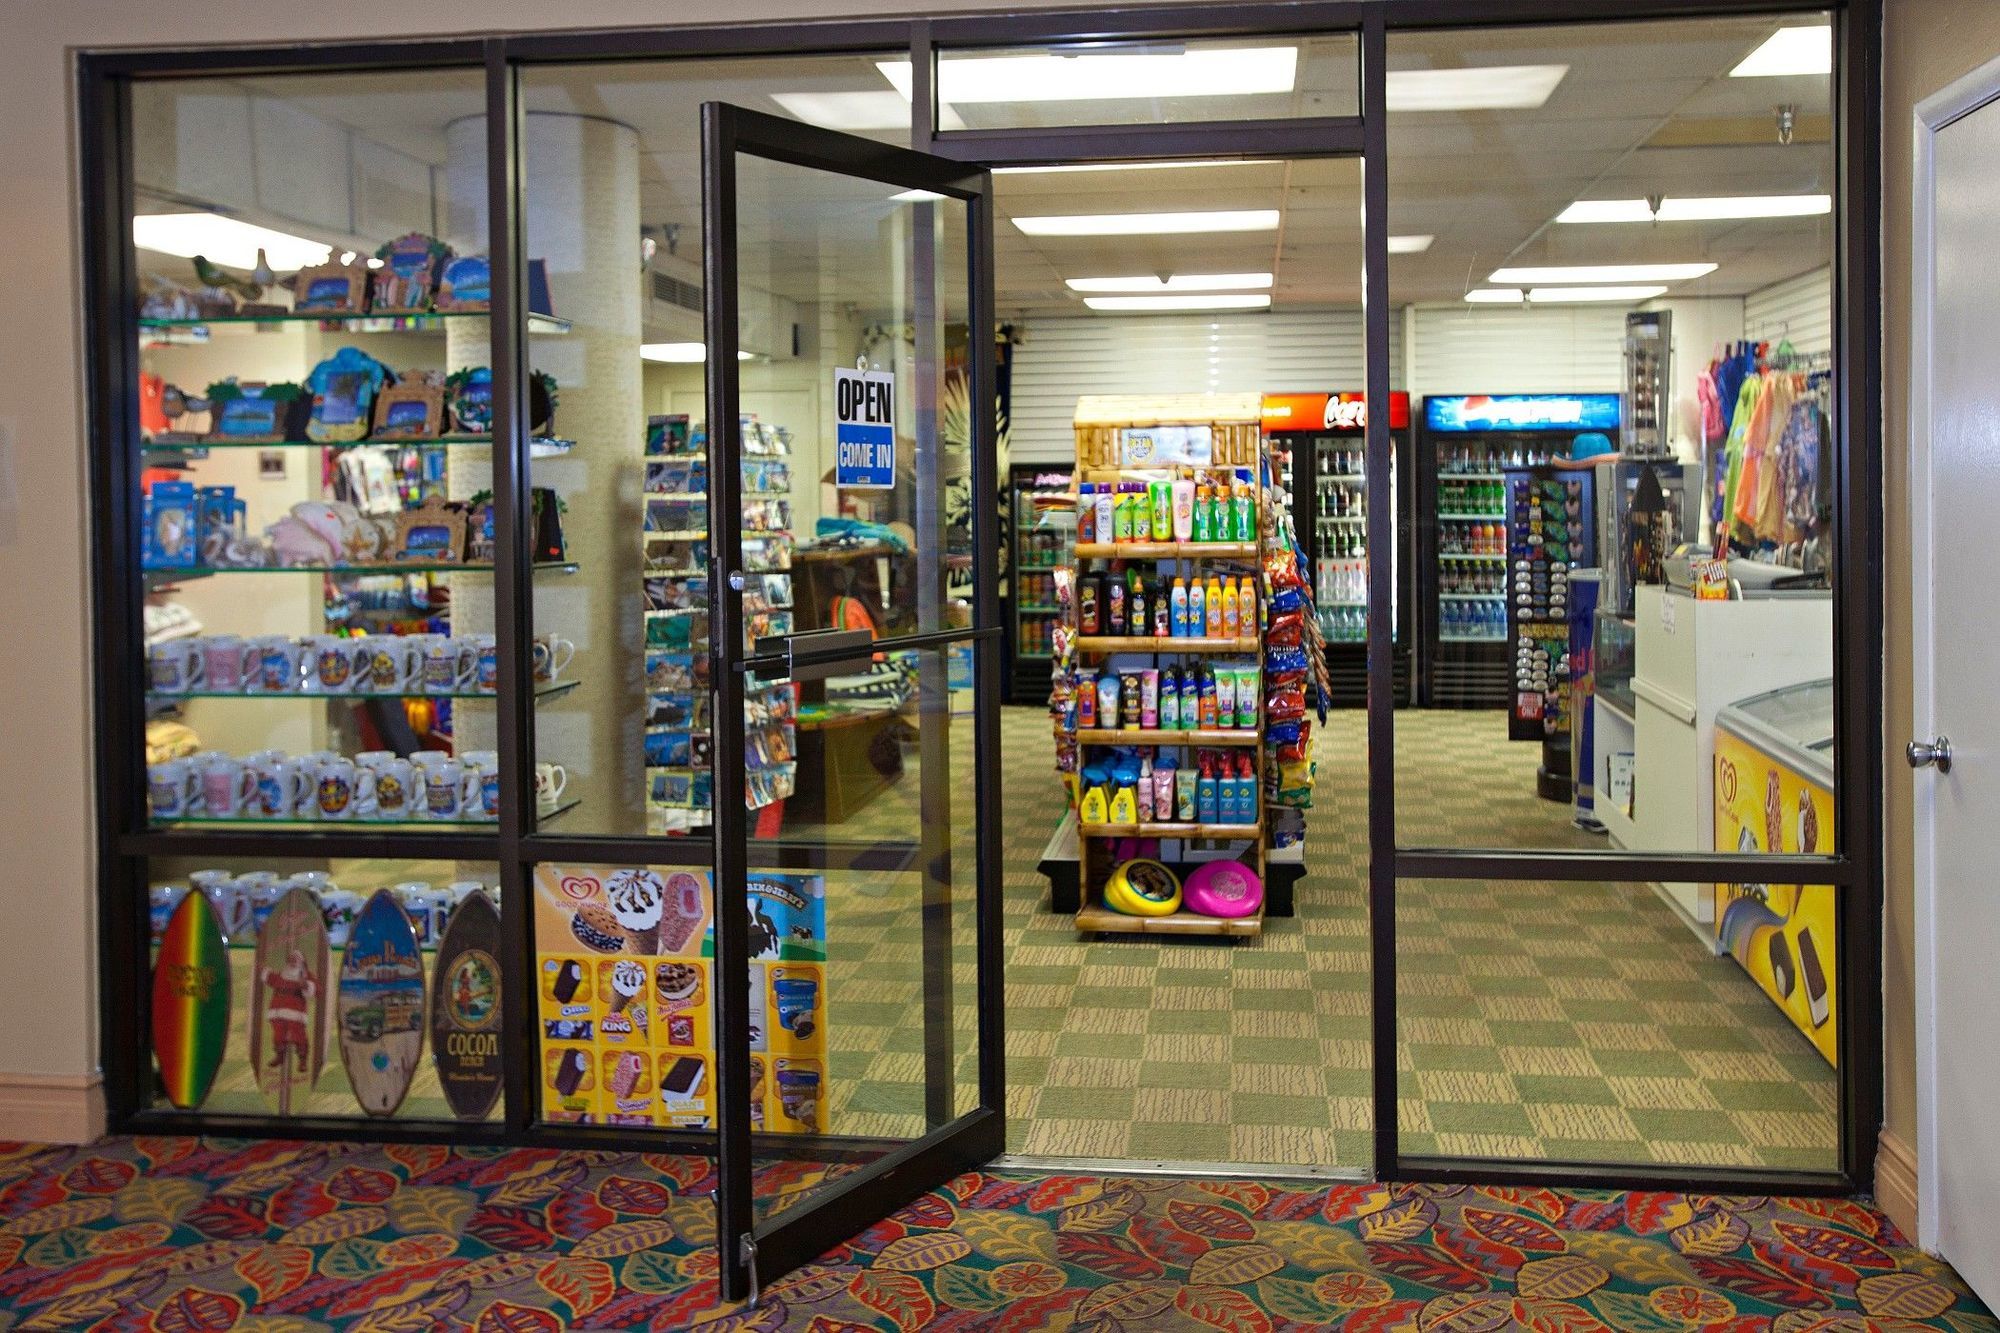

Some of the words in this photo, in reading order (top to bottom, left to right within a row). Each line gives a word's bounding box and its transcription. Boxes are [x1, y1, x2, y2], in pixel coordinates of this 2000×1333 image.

[838, 377, 891, 423] OPEN
[840, 442, 873, 468] COME
[877, 444, 891, 469] IN
[601, 1020, 632, 1033] KING
[447, 1032, 498, 1056] COCOA
